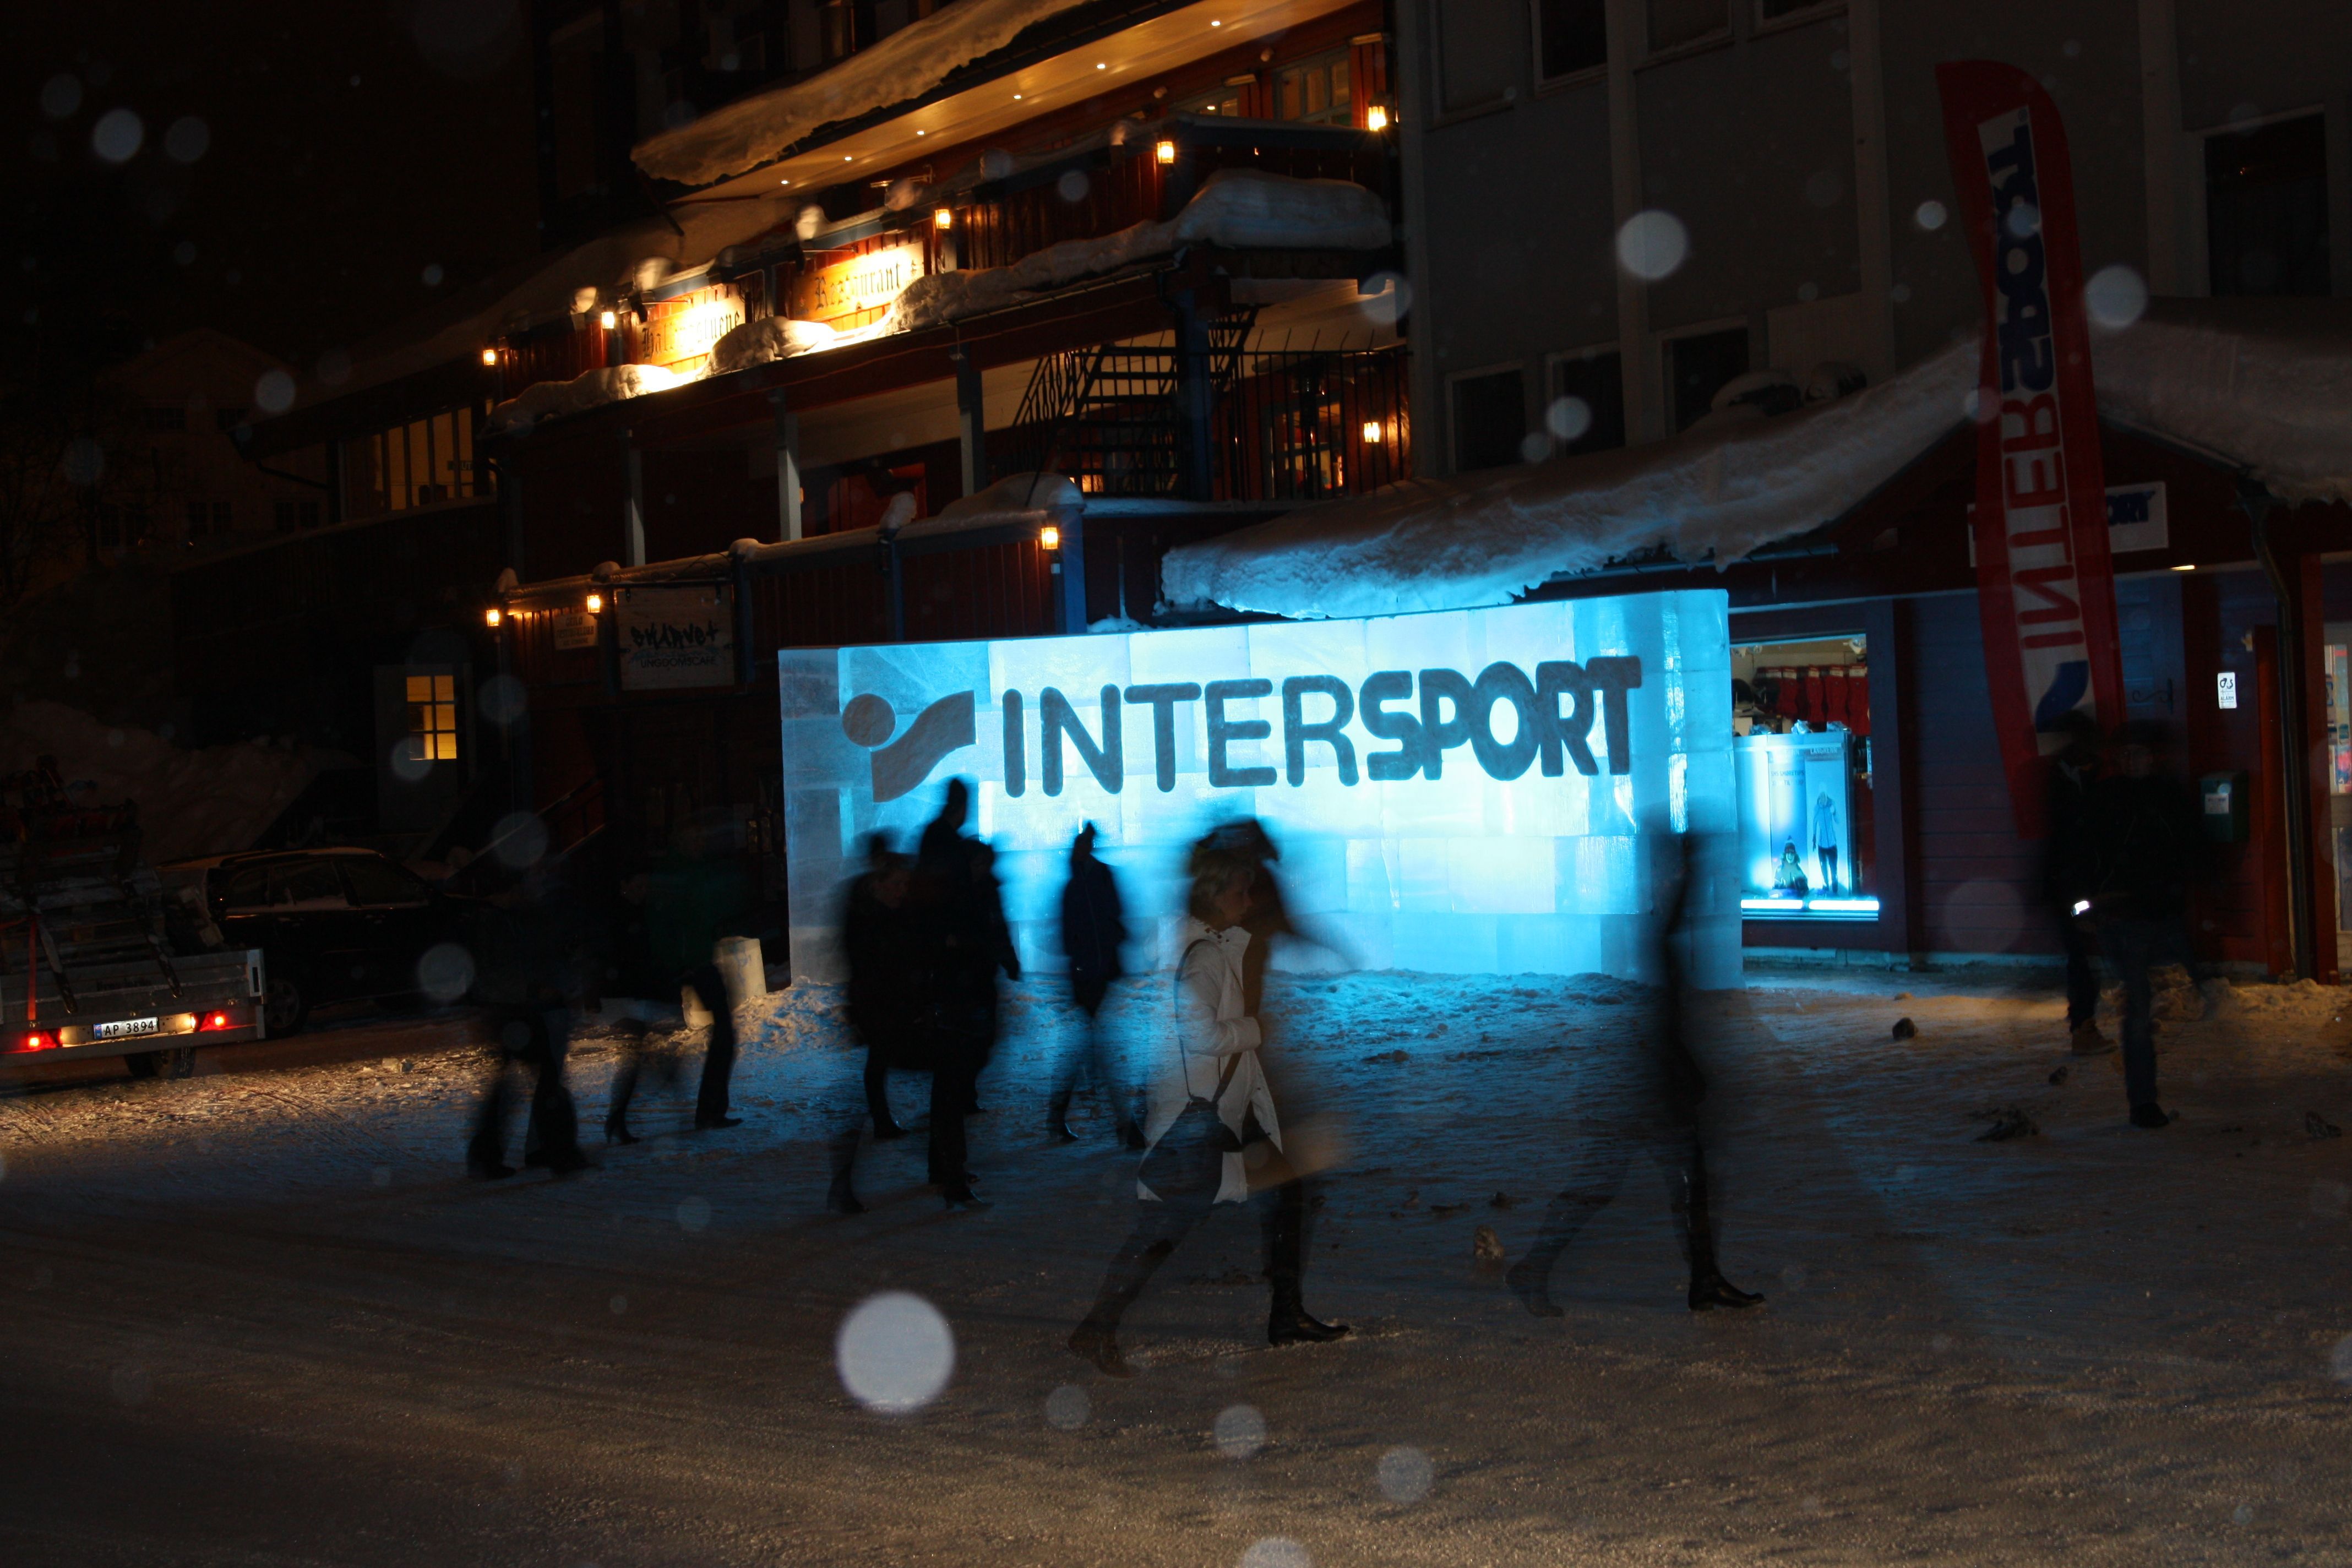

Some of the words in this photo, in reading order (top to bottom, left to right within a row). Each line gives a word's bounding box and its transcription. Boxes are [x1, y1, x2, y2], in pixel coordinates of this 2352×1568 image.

[1002, 655, 1642, 798] INTERSPORT
[105, 1025, 121, 1036] AP
[126, 1021, 155, 1033] 3894
